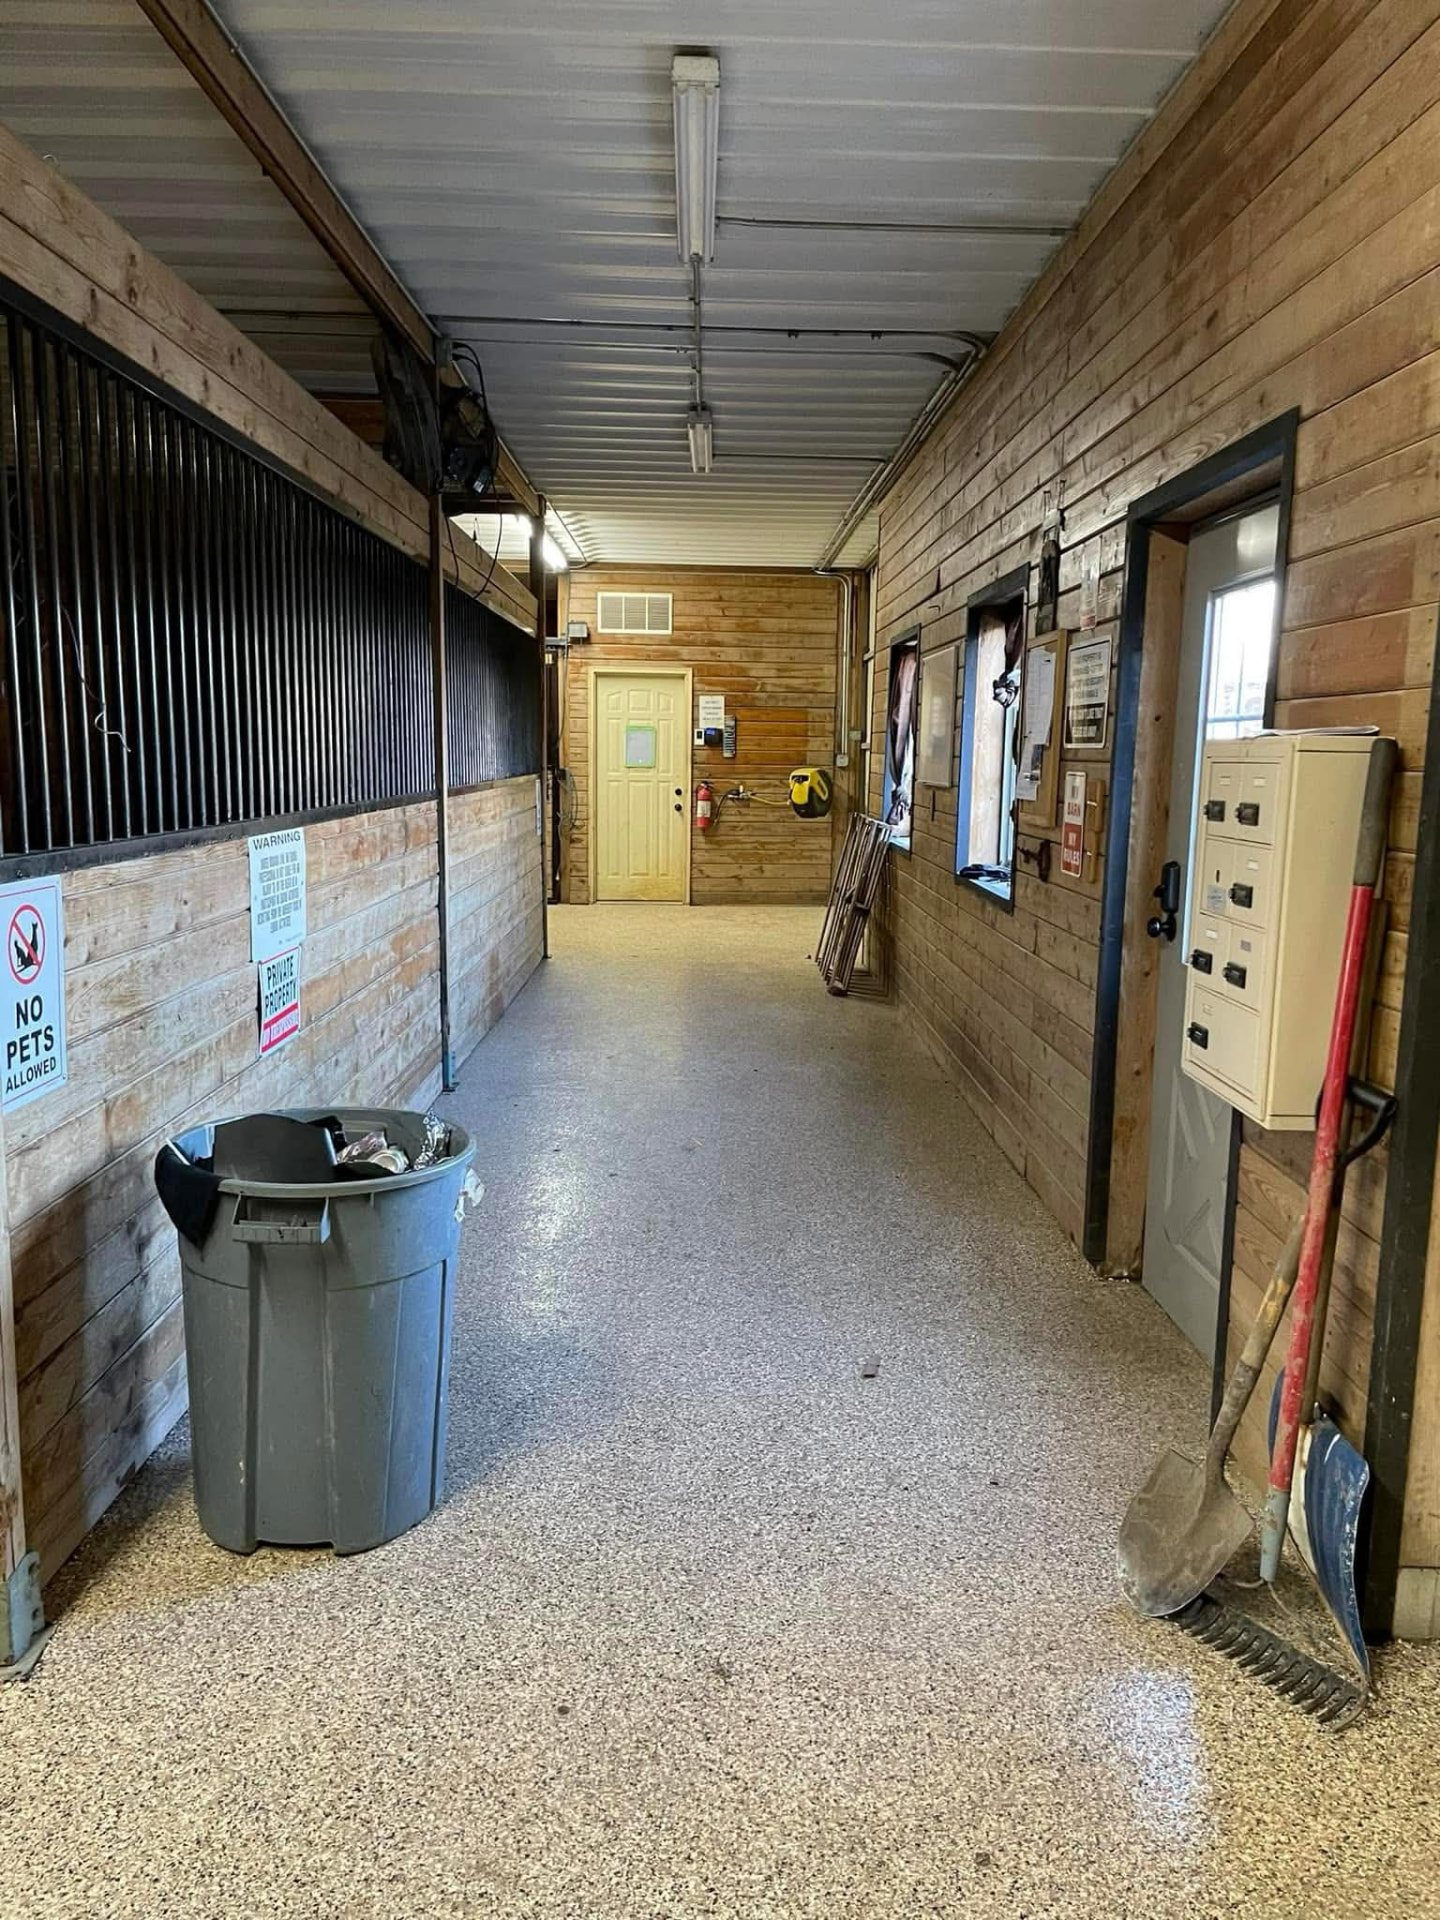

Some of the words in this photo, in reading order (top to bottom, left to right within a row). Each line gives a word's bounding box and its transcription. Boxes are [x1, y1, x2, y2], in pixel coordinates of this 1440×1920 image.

[253, 830, 301, 851] WARNING
[267, 955, 294, 990] PRIVATE
[16, 995, 43, 1029] NO
[265, 979, 297, 1017] PROPERTY
[7, 1025, 54, 1070] PETS
[5, 1056, 57, 1094] ALLOWED
